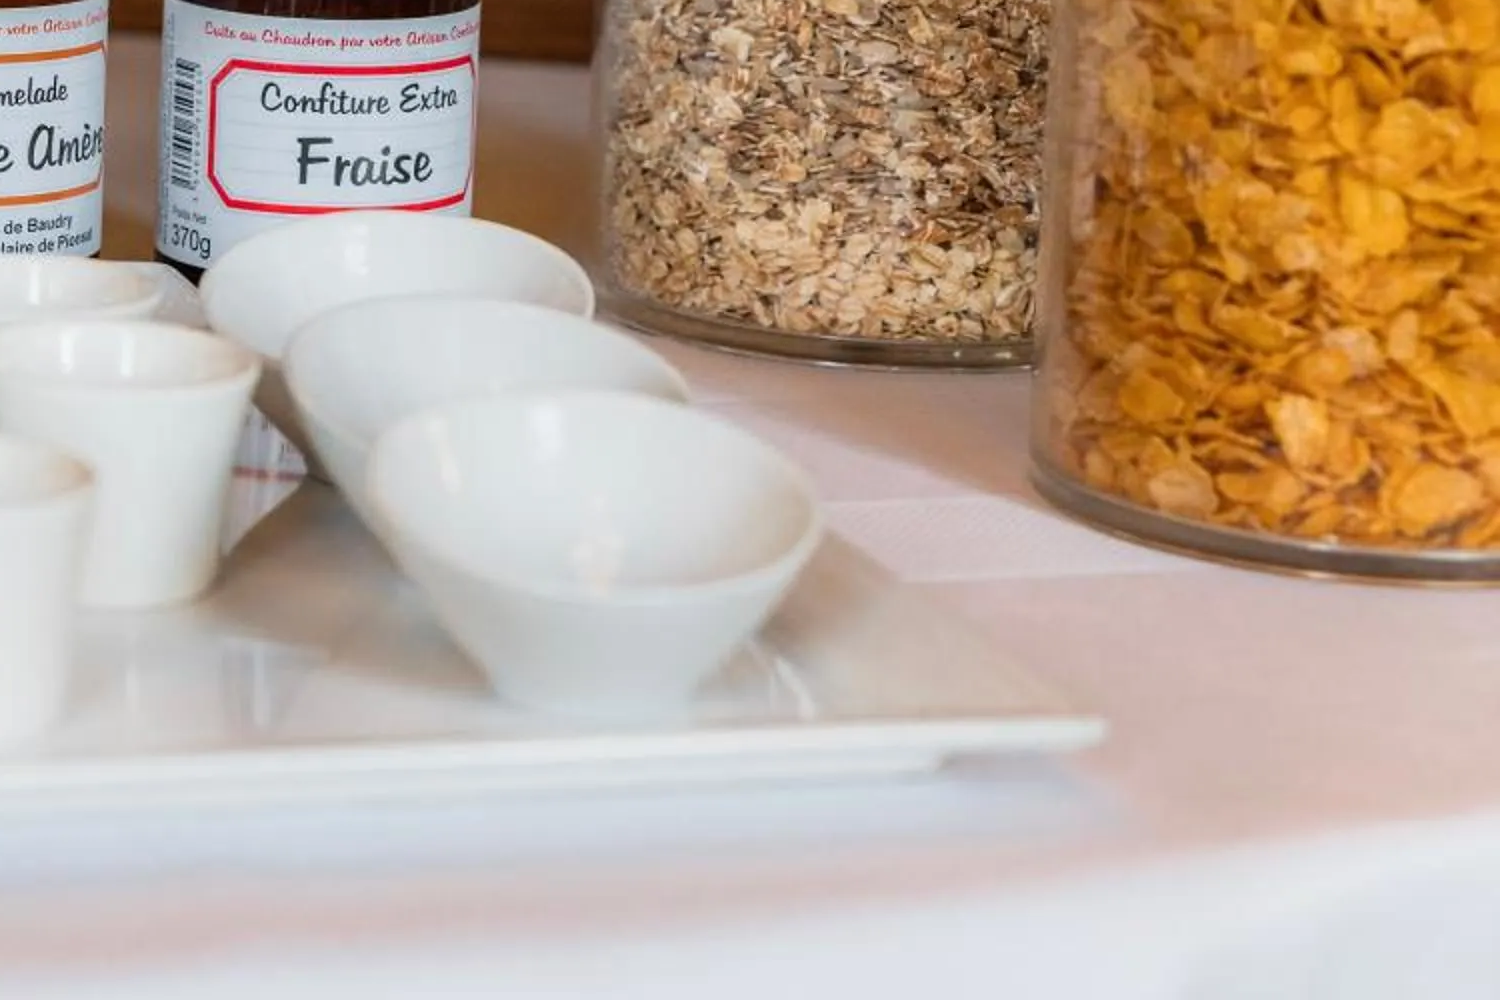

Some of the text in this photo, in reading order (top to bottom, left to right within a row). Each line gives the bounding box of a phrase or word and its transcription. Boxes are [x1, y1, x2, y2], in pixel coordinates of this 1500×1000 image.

[7, 21, 39, 35] votre
[204, 20, 235, 39] Cuite
[240, 30, 257, 42] au
[262, 28, 336, 48] Chaudron
[339, 34, 364, 51] par
[368, 34, 402, 47] votre
[261, 81, 459, 116] Confiture Extra
[296, 137, 434, 187] Fraise
[3, 219, 23, 235] de
[27, 213, 73, 232] Baudry
[37, 237, 55, 253] de
[171, 223, 211, 260] 370g
